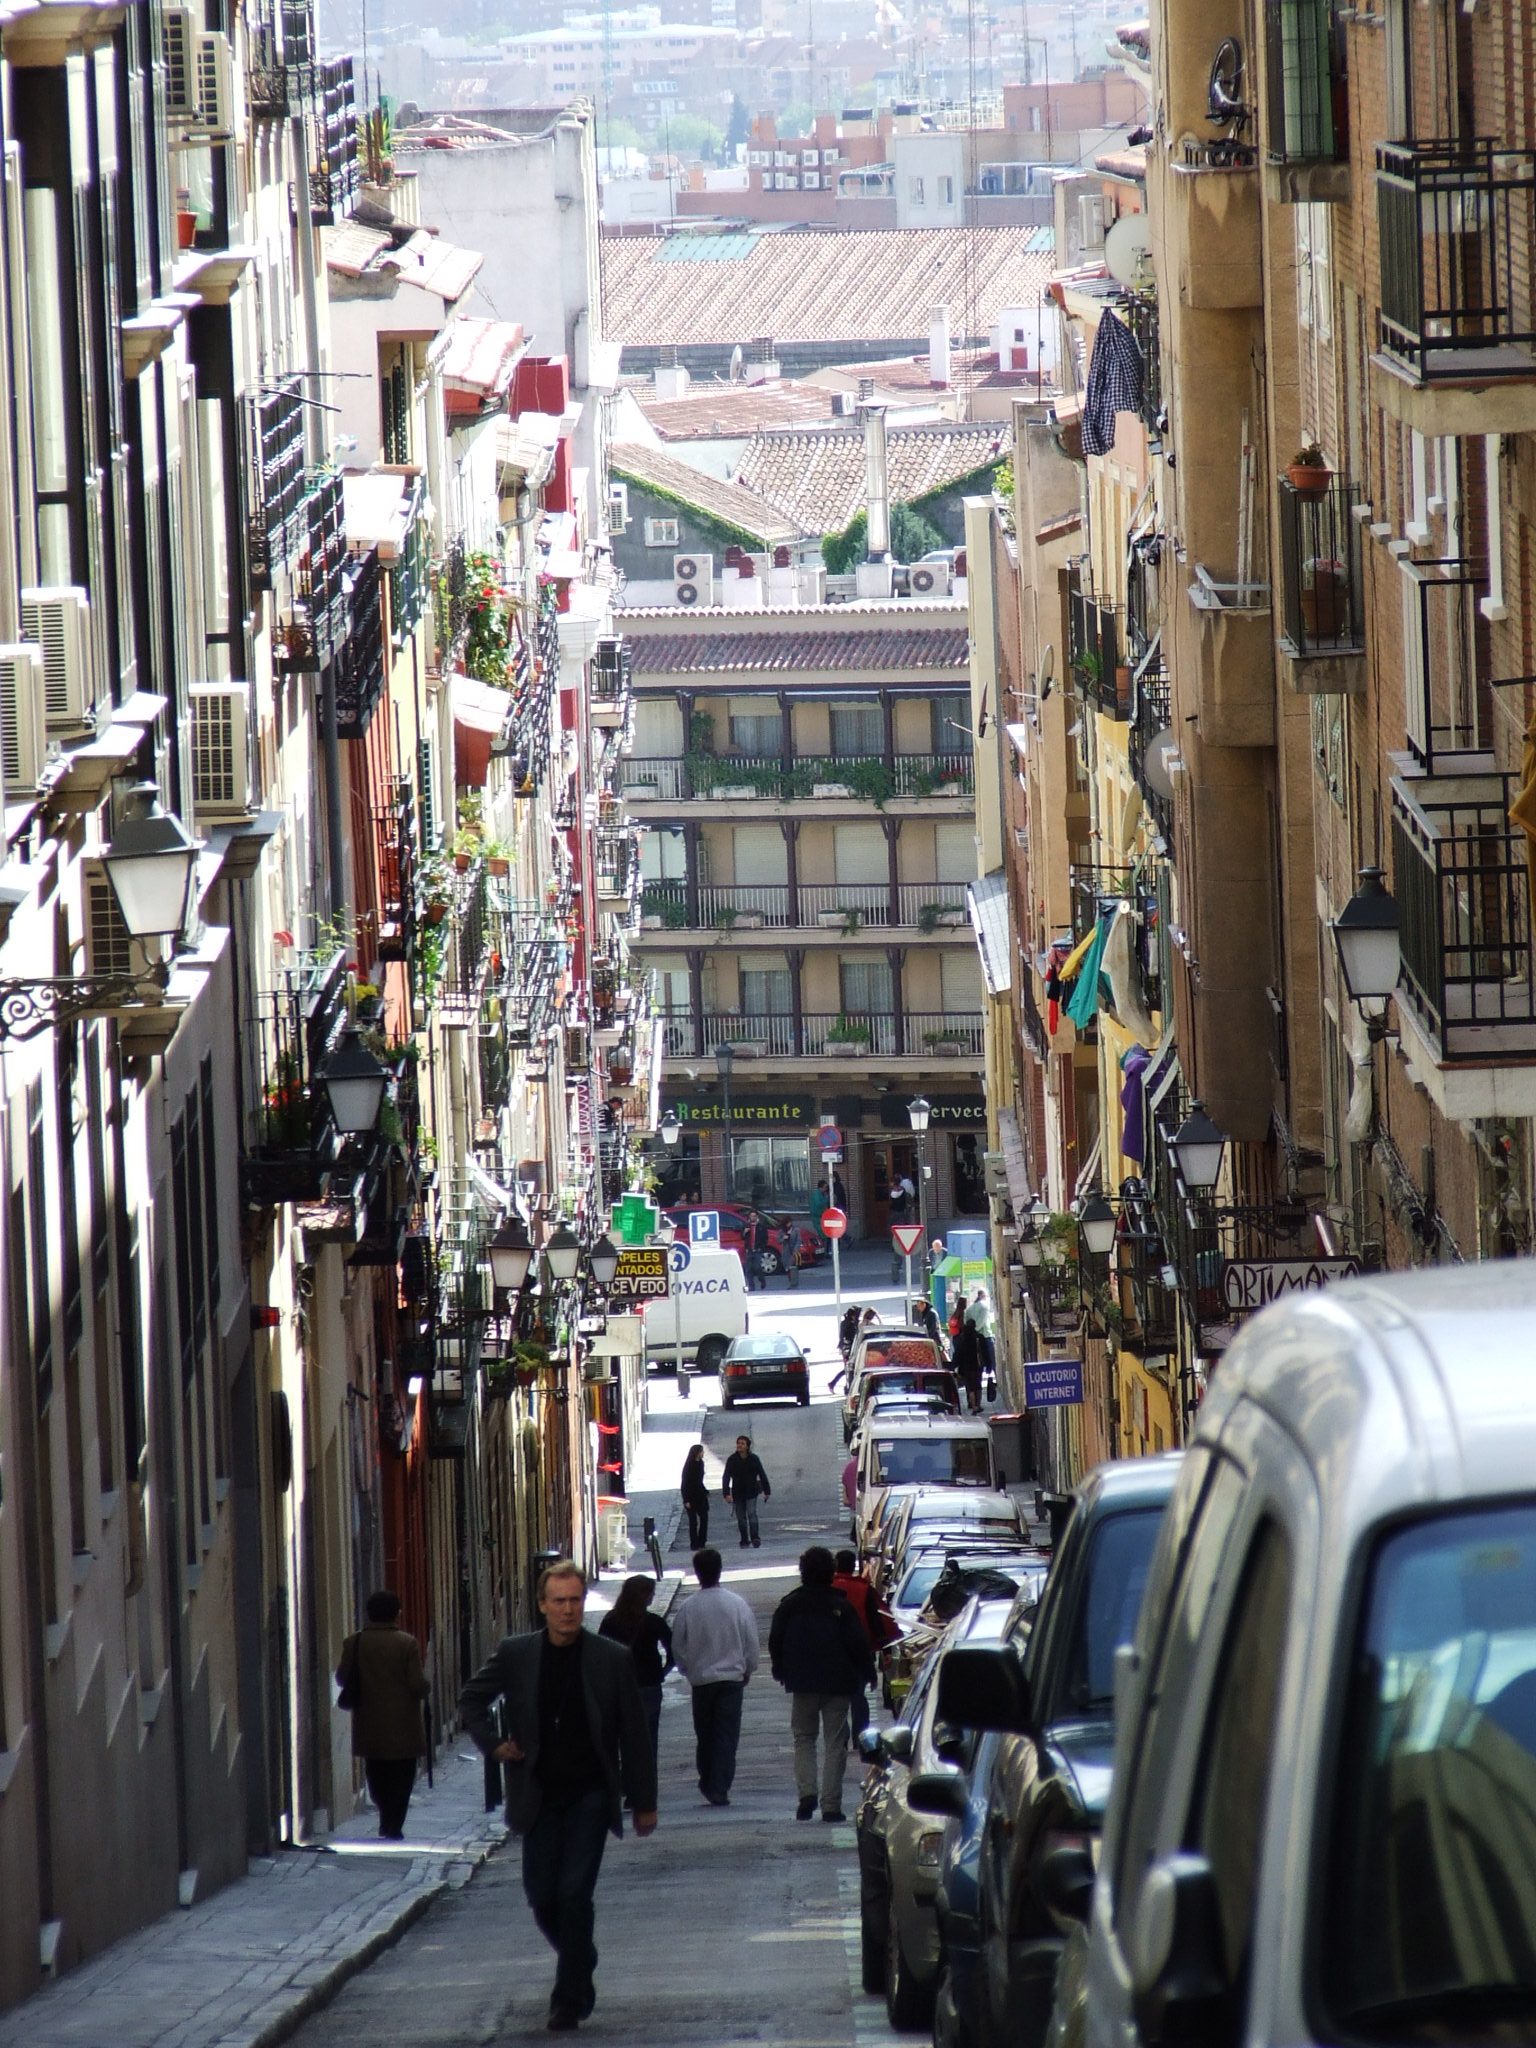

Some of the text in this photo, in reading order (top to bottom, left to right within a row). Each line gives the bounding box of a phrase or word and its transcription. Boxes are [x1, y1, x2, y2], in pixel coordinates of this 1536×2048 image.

[676, 1103, 801, 1120] Restaurante
[931, 1107, 988, 1118] ervec
[696, 1215, 710, 1240] P
[619, 1252, 660, 1263] PELES
[616, 1265, 663, 1275] NTADOS
[609, 1277, 666, 1294] CEVEDO
[1029, 1368, 1078, 1384] LOCUTORIO
[1034, 1385, 1075, 1400] INTERNET
